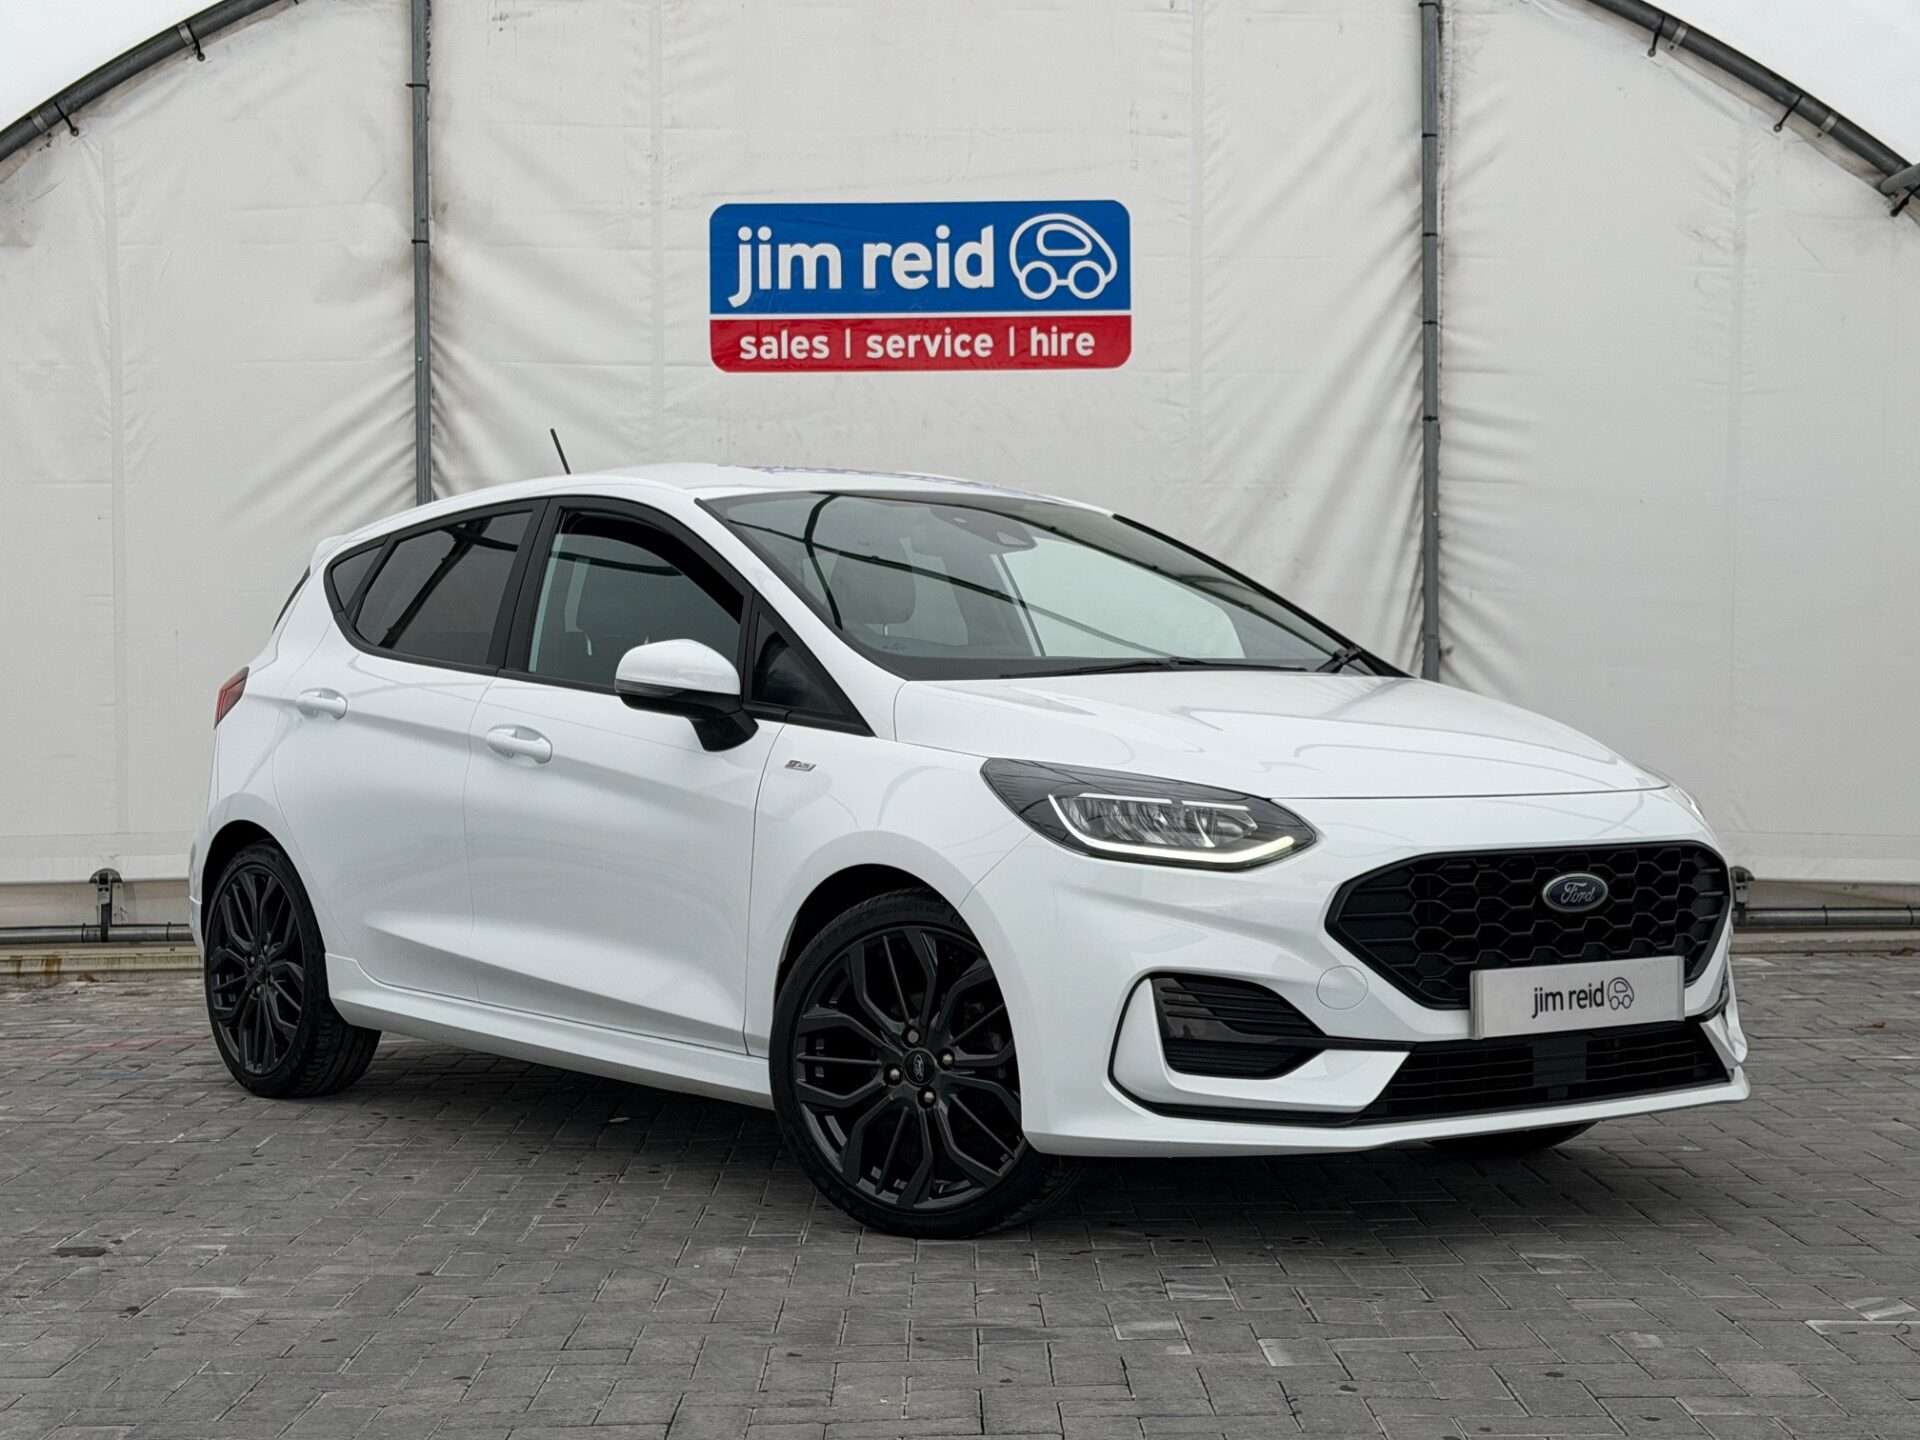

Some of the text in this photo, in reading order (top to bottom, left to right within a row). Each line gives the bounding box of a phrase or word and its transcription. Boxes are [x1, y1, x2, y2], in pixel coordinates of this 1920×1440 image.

[728, 224, 994, 308] jim reid
[739, 326, 1095, 361] sales service hire
[1561, 882, 1596, 904] Ford
[1532, 981, 1605, 1019] jim reid
